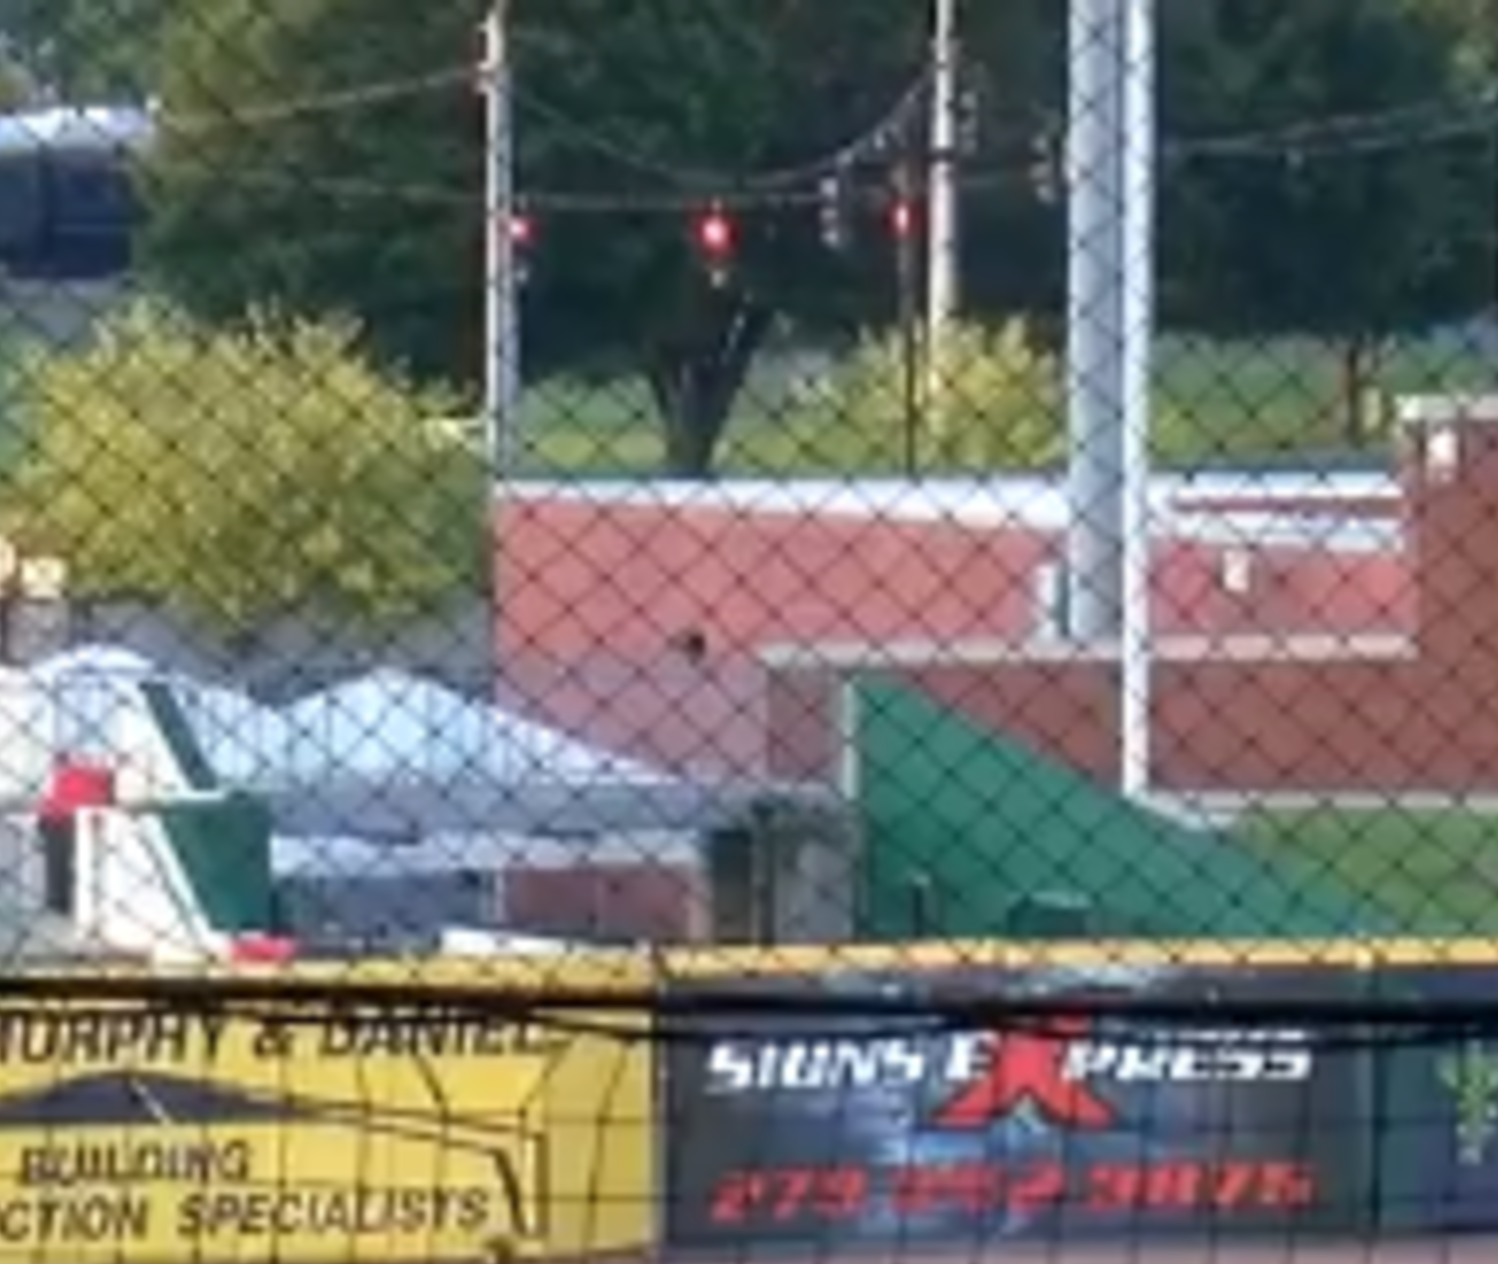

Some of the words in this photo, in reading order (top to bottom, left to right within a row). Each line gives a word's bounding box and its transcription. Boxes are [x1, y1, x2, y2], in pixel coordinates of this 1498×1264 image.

[704, 1034, 927, 1093] SIGNS
[17, 1139, 253, 1189] BUILDING
[175, 1188, 493, 1239] SPECIALISTS
